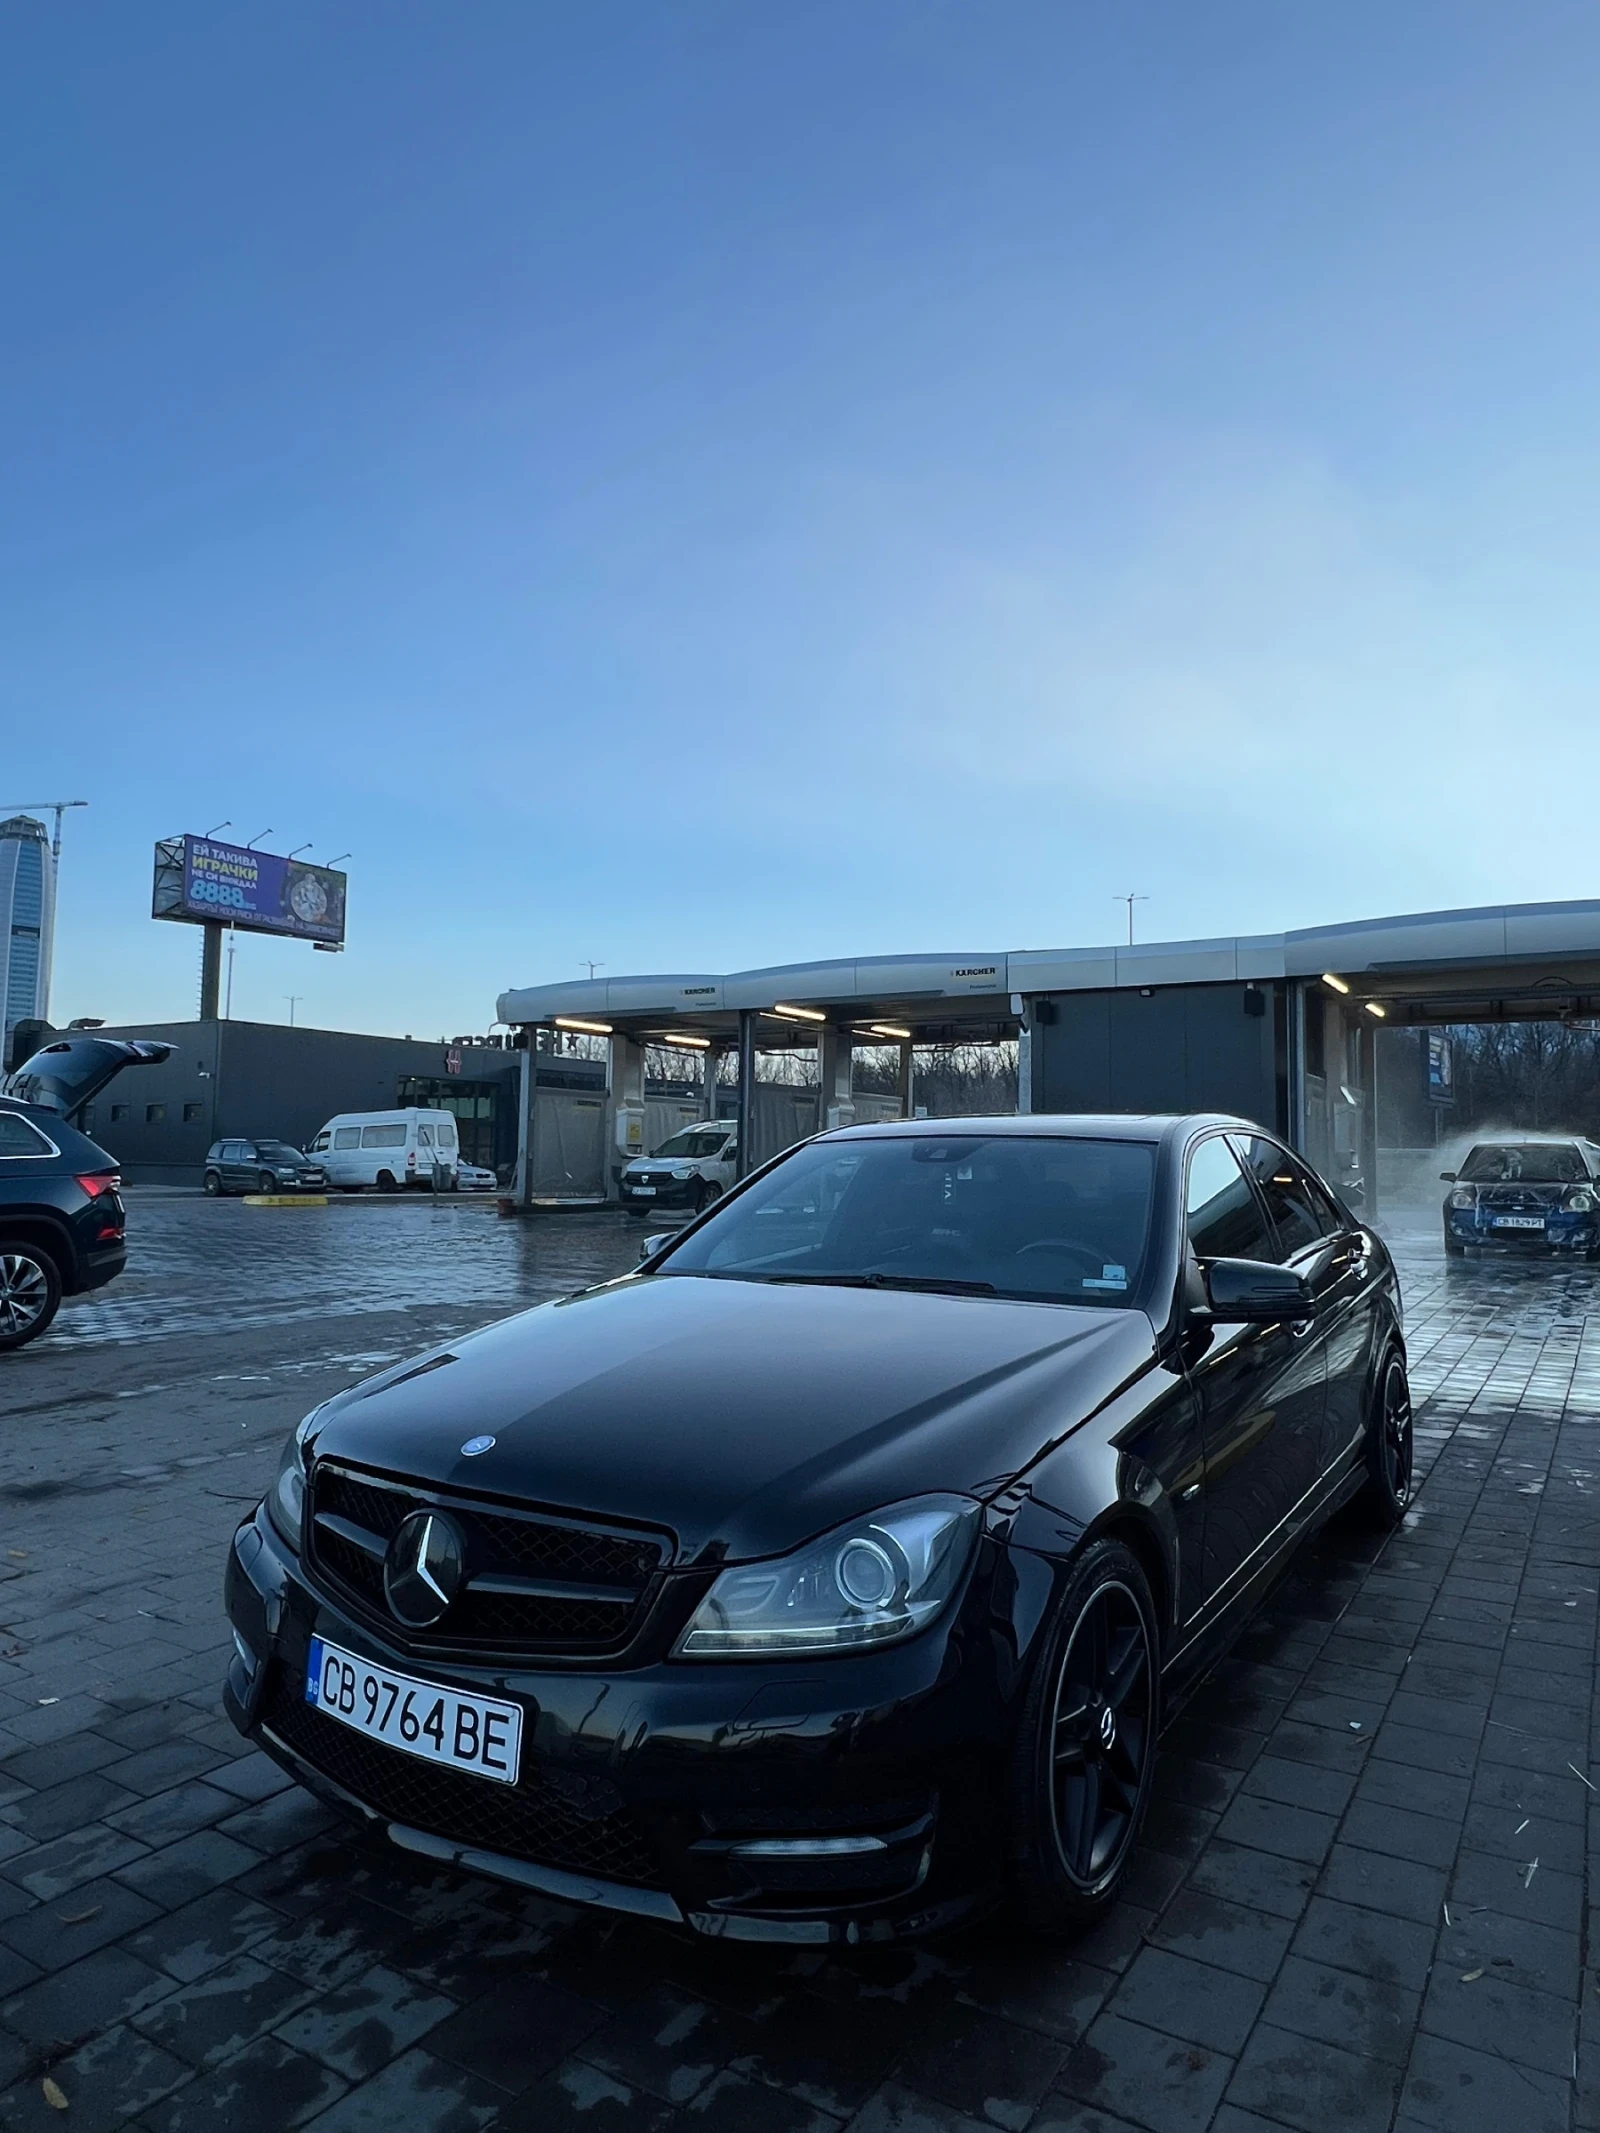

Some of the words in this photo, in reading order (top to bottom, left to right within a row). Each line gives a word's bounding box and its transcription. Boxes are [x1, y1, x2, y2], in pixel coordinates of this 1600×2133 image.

[192, 855, 258, 881] ИГРАЧКИ
[193, 844, 209, 857] ЕЙ
[211, 848, 258, 869] ТАКИВА
[191, 868, 204, 878] НЕ
[205, 871, 218, 881] СИ
[307, 1677, 319, 1695] BG
[323, 1655, 356, 1715] CB
[363, 1675, 446, 1752] 9764
[453, 1703, 511, 1771] BE
